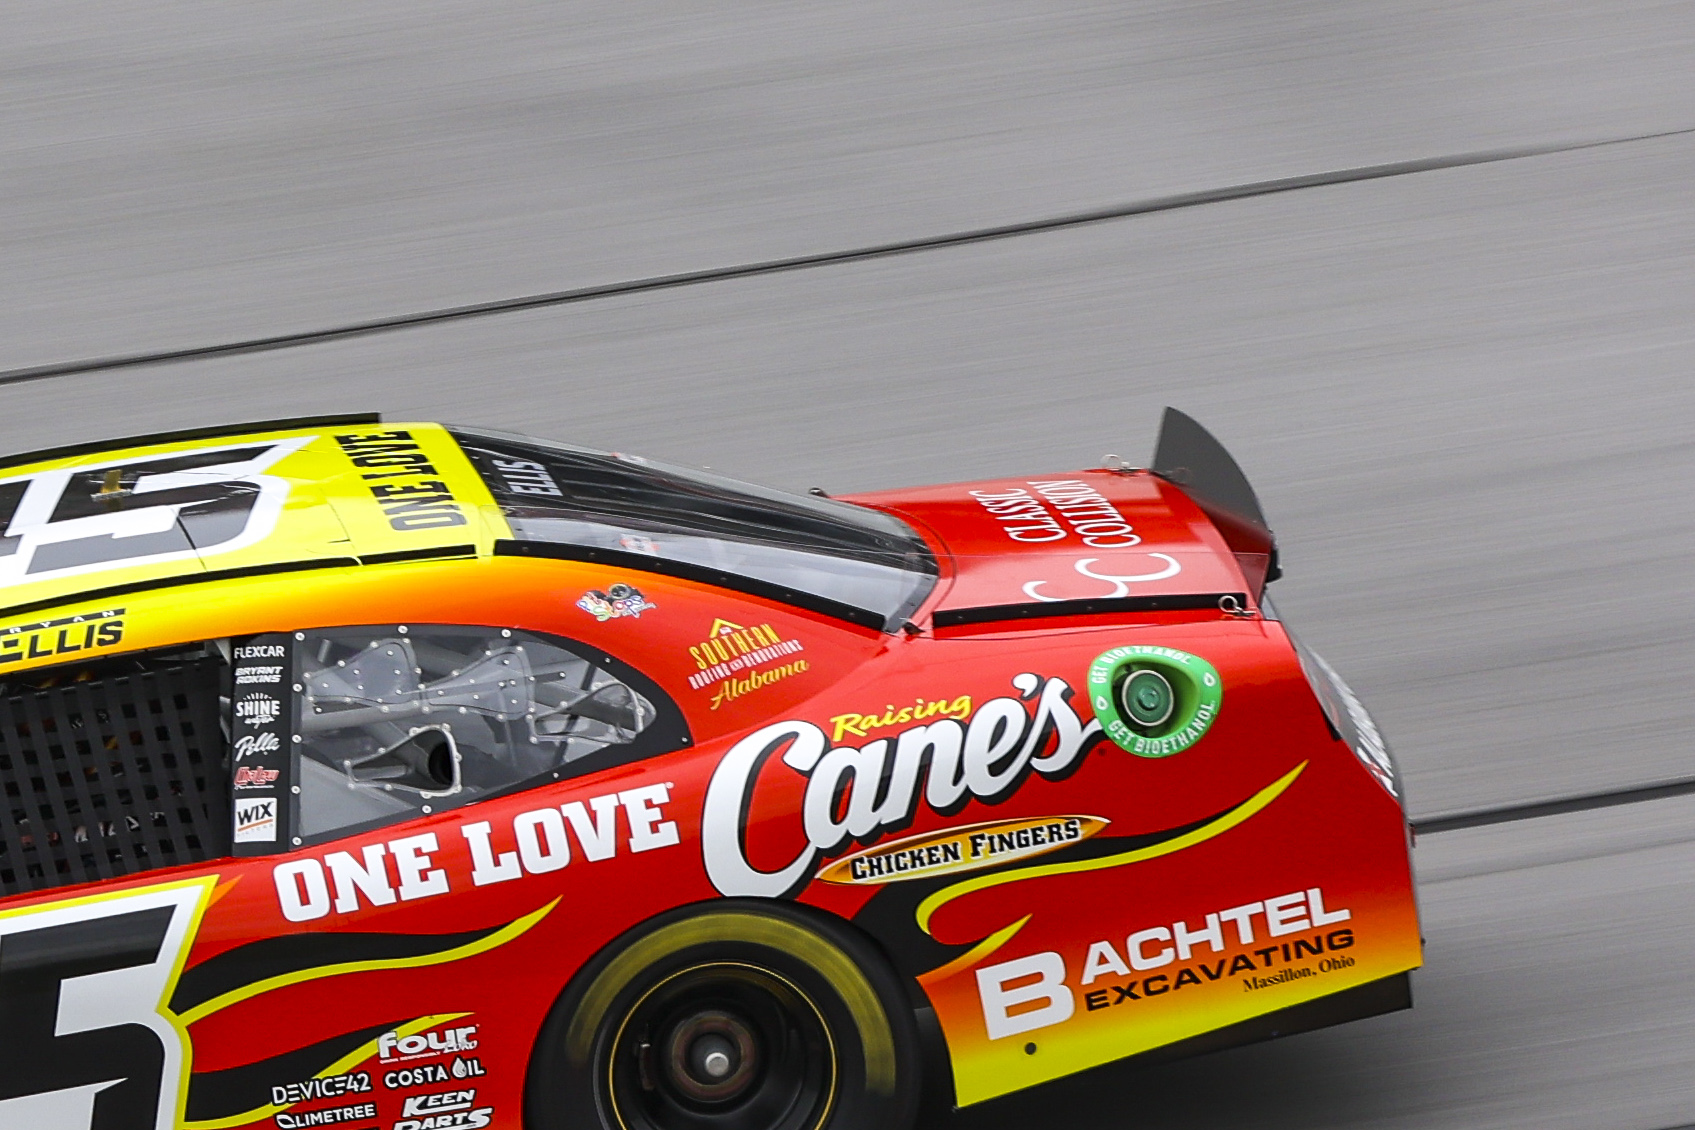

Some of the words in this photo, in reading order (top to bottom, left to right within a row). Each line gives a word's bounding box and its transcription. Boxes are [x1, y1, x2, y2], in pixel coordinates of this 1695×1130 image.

[333, 430, 440, 481] LOVE
[491, 459, 564, 497] ELLIS
[370, 481, 467, 531] ONE
[968, 488, 1068, 542] CLASSIC
[1026, 479, 1142, 548] COLLISION
[9, 601, 115, 634] RYAN
[233, 645, 286, 659] FLEXCAR
[688, 623, 782, 670] SOUTHERN
[235, 700, 281, 717] SHINE
[710, 659, 810, 711] Alabama
[830, 695, 972, 742] Raising
[1108, 719, 1136, 747] GET
[1133, 702, 1217, 756] BIOETHANOL
[703, 672, 1104, 898] Cane's
[237, 801, 275, 827] WIX
[273, 832, 450, 922] ONE
[461, 782, 681, 887] LOVE
[850, 841, 959, 881] CHICKEN
[968, 819, 1081, 857] FINGERS
[975, 886, 1352, 1041] BACHTEL
[1084, 928, 1355, 1012] EXCAVATING
[1242, 967, 1317, 993] Massillon,
[1318, 955, 1356, 973] Ohio
[379, 1026, 477, 1059] four
[271, 1072, 372, 1104] DEVICE42
[384, 1064, 449, 1088] COSTA
[294, 1103, 376, 1128] LIMETREE
[402, 1089, 475, 1118] KEEN
